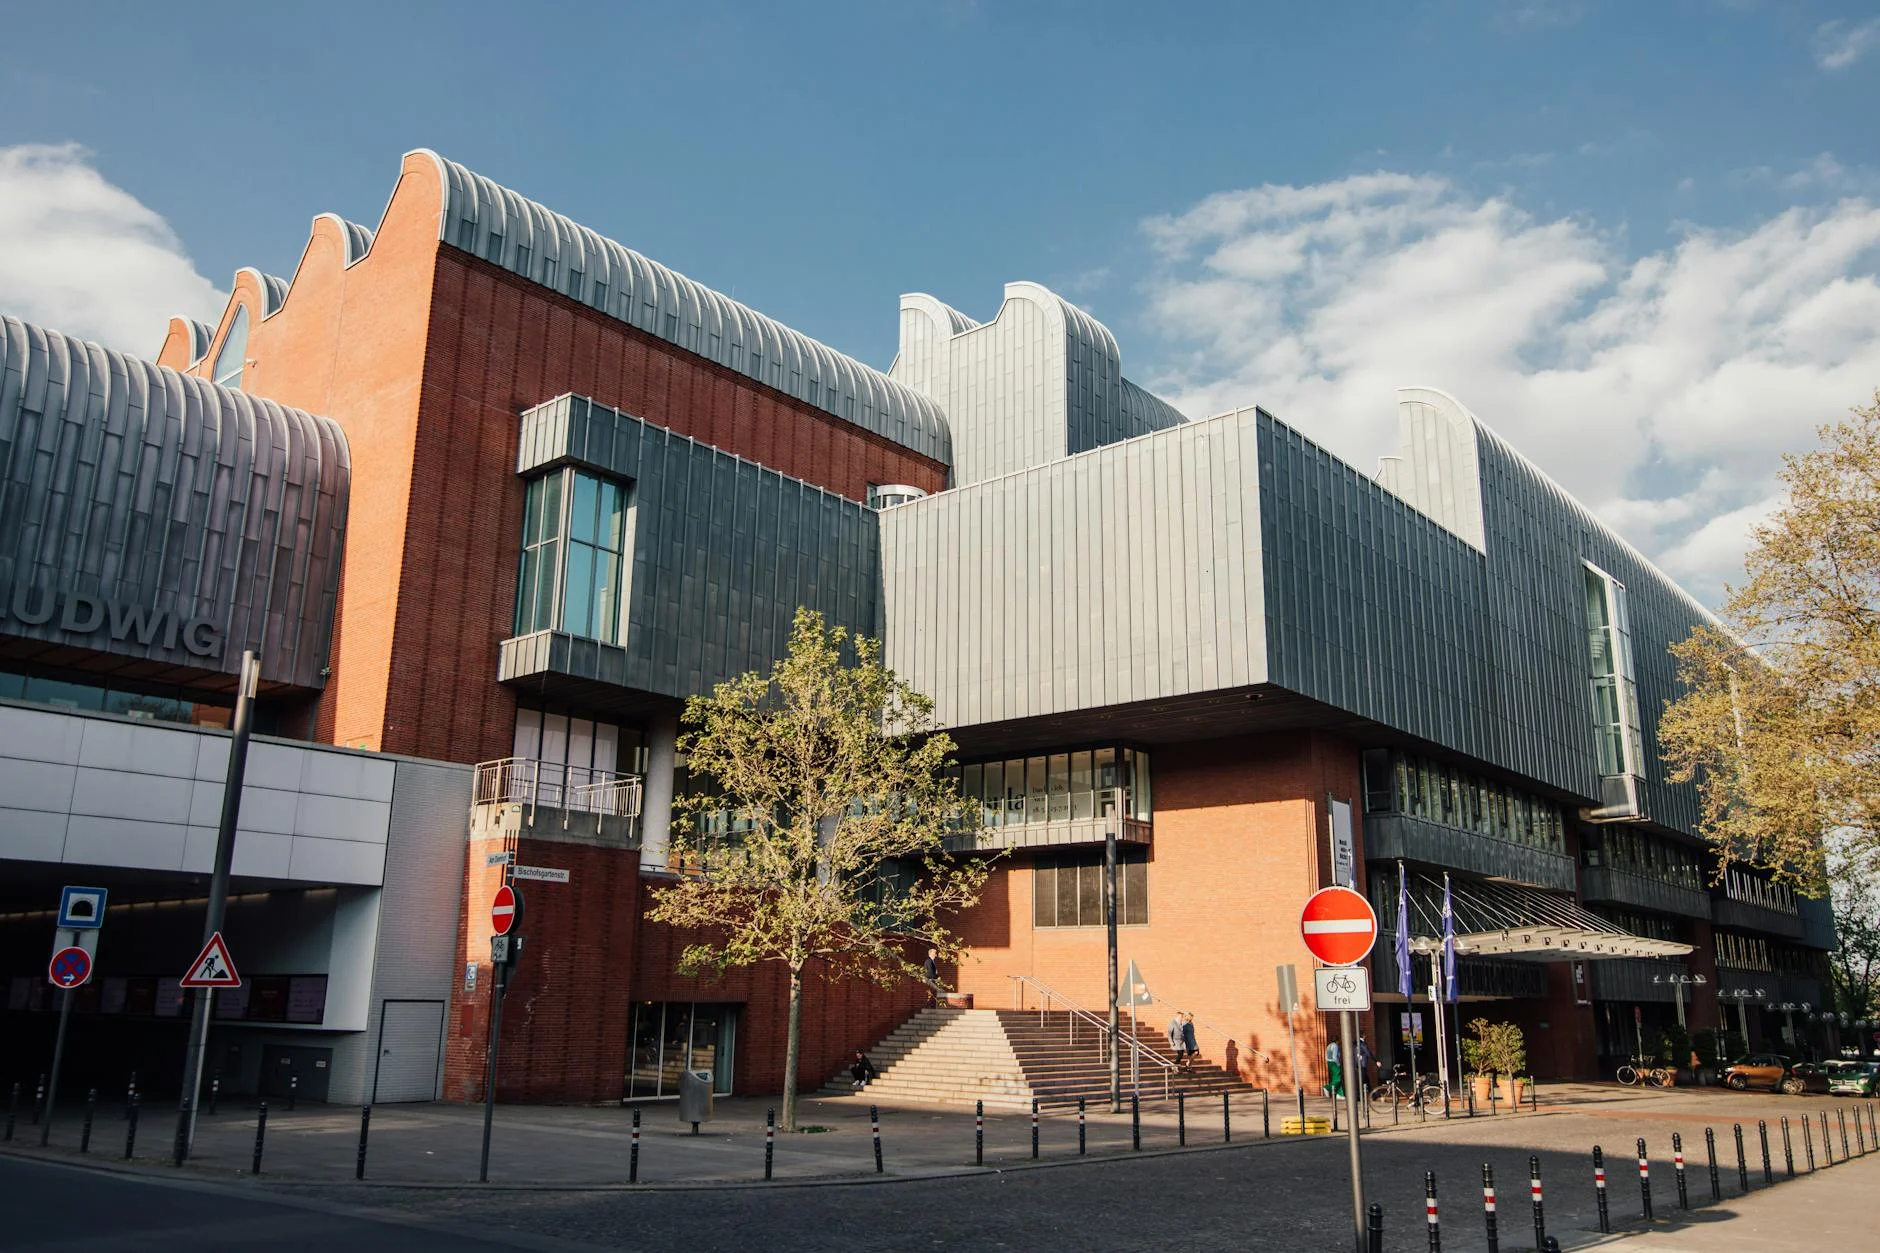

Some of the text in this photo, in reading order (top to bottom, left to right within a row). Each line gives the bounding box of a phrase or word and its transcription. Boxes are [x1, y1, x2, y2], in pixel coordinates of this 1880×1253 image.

[0, 579, 223, 657] UDWIG
[518, 867, 566, 879] Bischofsgartenstr.
[1334, 995, 1351, 1005] frei
